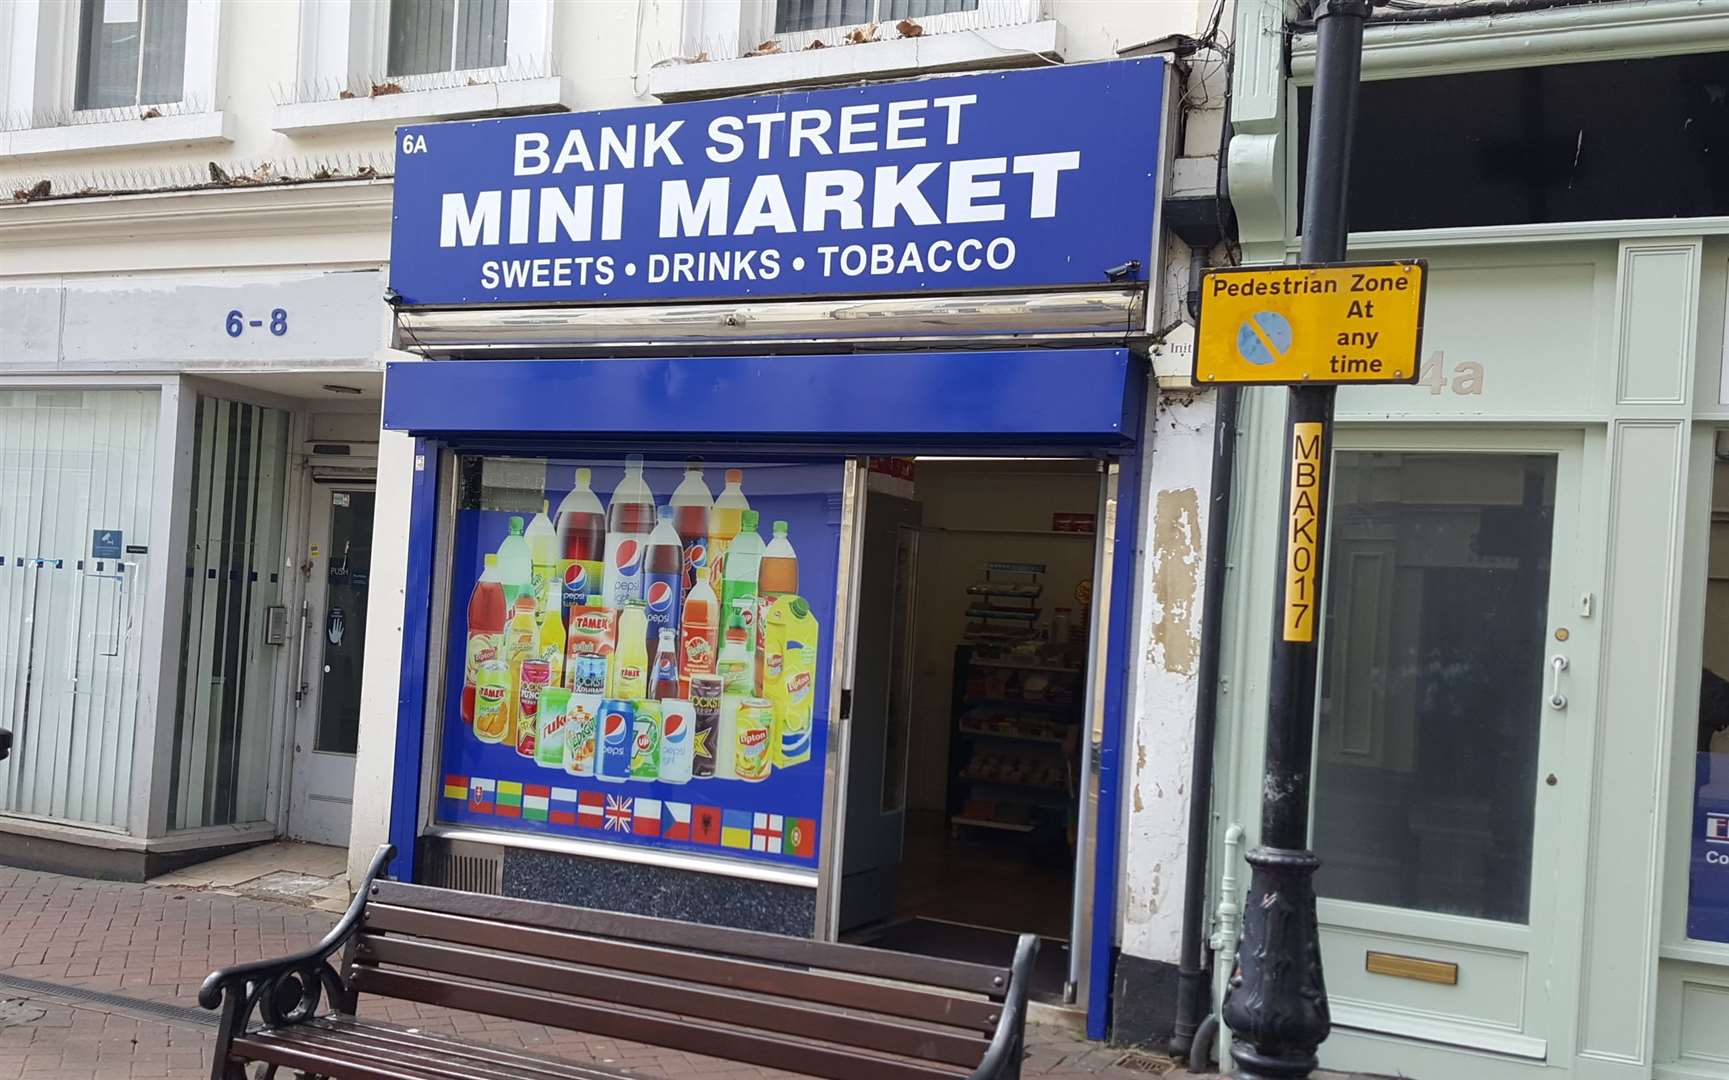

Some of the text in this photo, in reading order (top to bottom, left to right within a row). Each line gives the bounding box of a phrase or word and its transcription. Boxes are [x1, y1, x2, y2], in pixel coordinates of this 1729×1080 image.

[403, 134, 428, 155] 6A
[513, 94, 978, 177] BANK STREET
[439, 150, 1081, 248] MINI MARKET
[480, 237, 1016, 290] SWEETS DRINKS TOBACCO
[1213, 273, 1409, 297] Pedestrian Zone
[1347, 300, 1374, 318] At
[225, 308, 288, 338] 6-8
[1337, 331, 1379, 349] any
[1330, 355, 1383, 373] time
[562, 591, 586, 602] pepsi
[647, 612, 670, 625] pepsi
